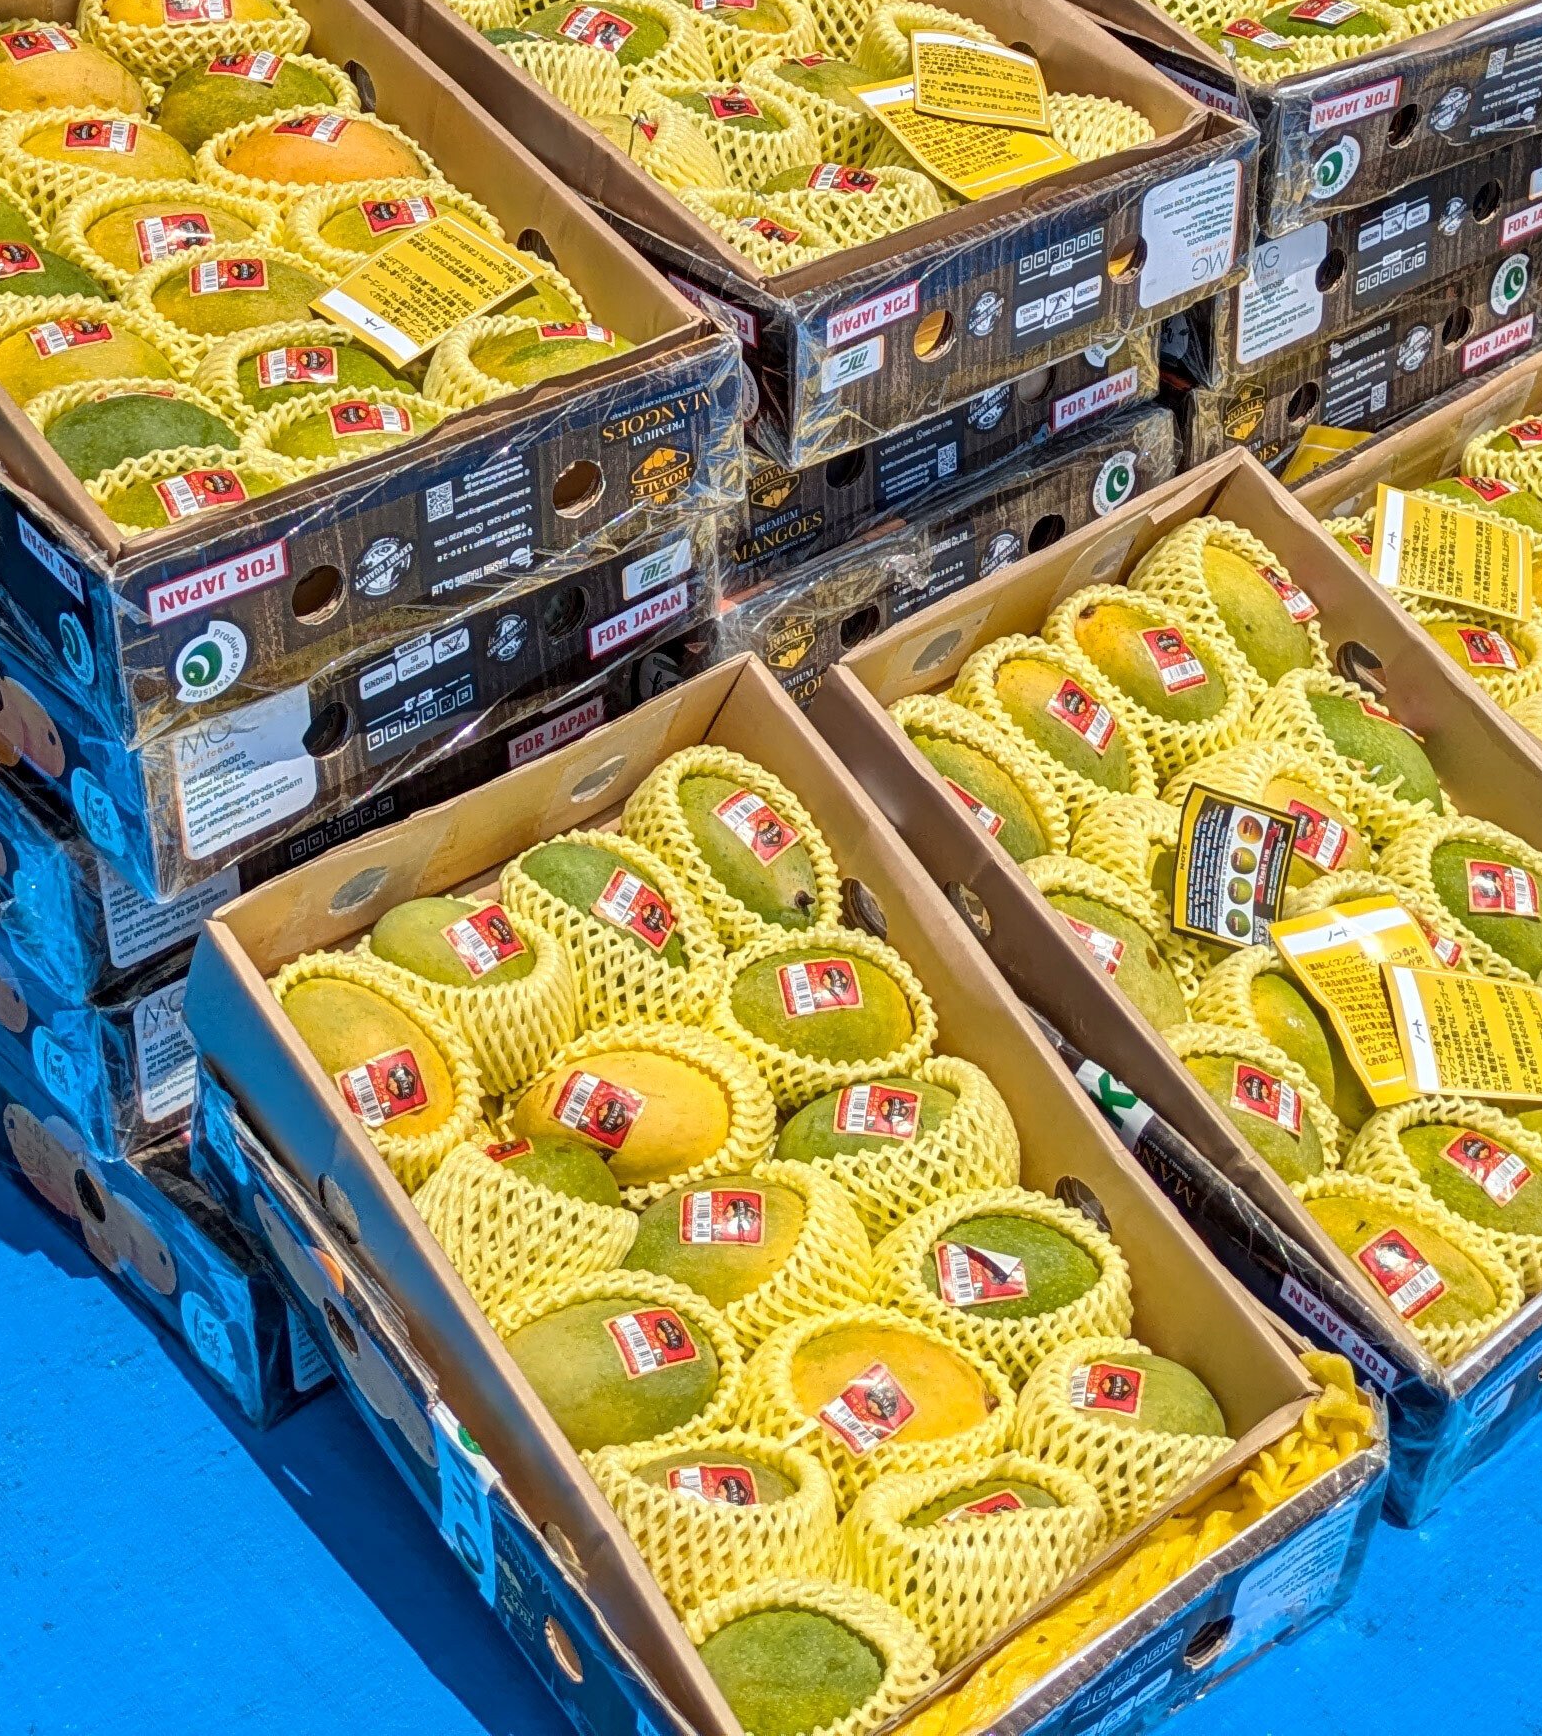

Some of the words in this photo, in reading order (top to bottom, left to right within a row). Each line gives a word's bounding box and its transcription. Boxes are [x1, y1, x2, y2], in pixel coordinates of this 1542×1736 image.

[1315, 94, 1366, 123] JAPAN
[1370, 85, 1395, 107] FOR
[1506, 208, 1530, 233] FOR
[1191, 248, 1229, 281] MG
[881, 292, 913, 322] FOR
[831, 304, 876, 343] JAPAN
[1468, 339, 1490, 360] FOR
[1492, 323, 1530, 349] JAPAN
[1059, 391, 1088, 419] FOR
[1090, 374, 1133, 406] JAPAN
[601, 389, 711, 445] MANGOES
[632, 420, 687, 446] PREMIUM
[633, 469, 689, 497] ROYALE
[734, 509, 825, 565] MANGOES
[753, 507, 800, 535] PREMIUM
[235, 555, 277, 586] FOR
[385, 541, 415, 568] EXPORT
[354, 560, 386, 591] QUALITY
[158, 571, 225, 613] JAPAN
[595, 613, 635, 647] FOR
[637, 589, 685, 630] JAPAN
[212, 626, 247, 661] Produce
[397, 635, 428, 654] VARIETY
[183, 668, 238, 700] Pakistan
[363, 672, 394, 692] SINDHRI
[180, 718, 232, 762] MG
[512, 729, 551, 762] FOR
[552, 704, 601, 748] JAPAN
[198, 750, 247, 782] AGRIFOODS
[185, 778, 213, 797] Masood
[187, 797, 213, 814] Punjab,
[213, 780, 246, 800] Pakistan.
[197, 786, 221, 802] Multan
[209, 774, 289, 817] info@mgagrifoods.com
[244, 798, 259, 811] +92
[192, 807, 272, 852] www.mgagrifoods.com
[1179, 843, 1188, 870] NOTE
[1262, 848, 1270, 861] us
[1257, 861, 1268, 886] Visit
[1430, 1025, 1448, 1087] マンゴーの食べ方
[1284, 1282, 1356, 1351] JAPAN
[1359, 1341, 1396, 1389] FOR
